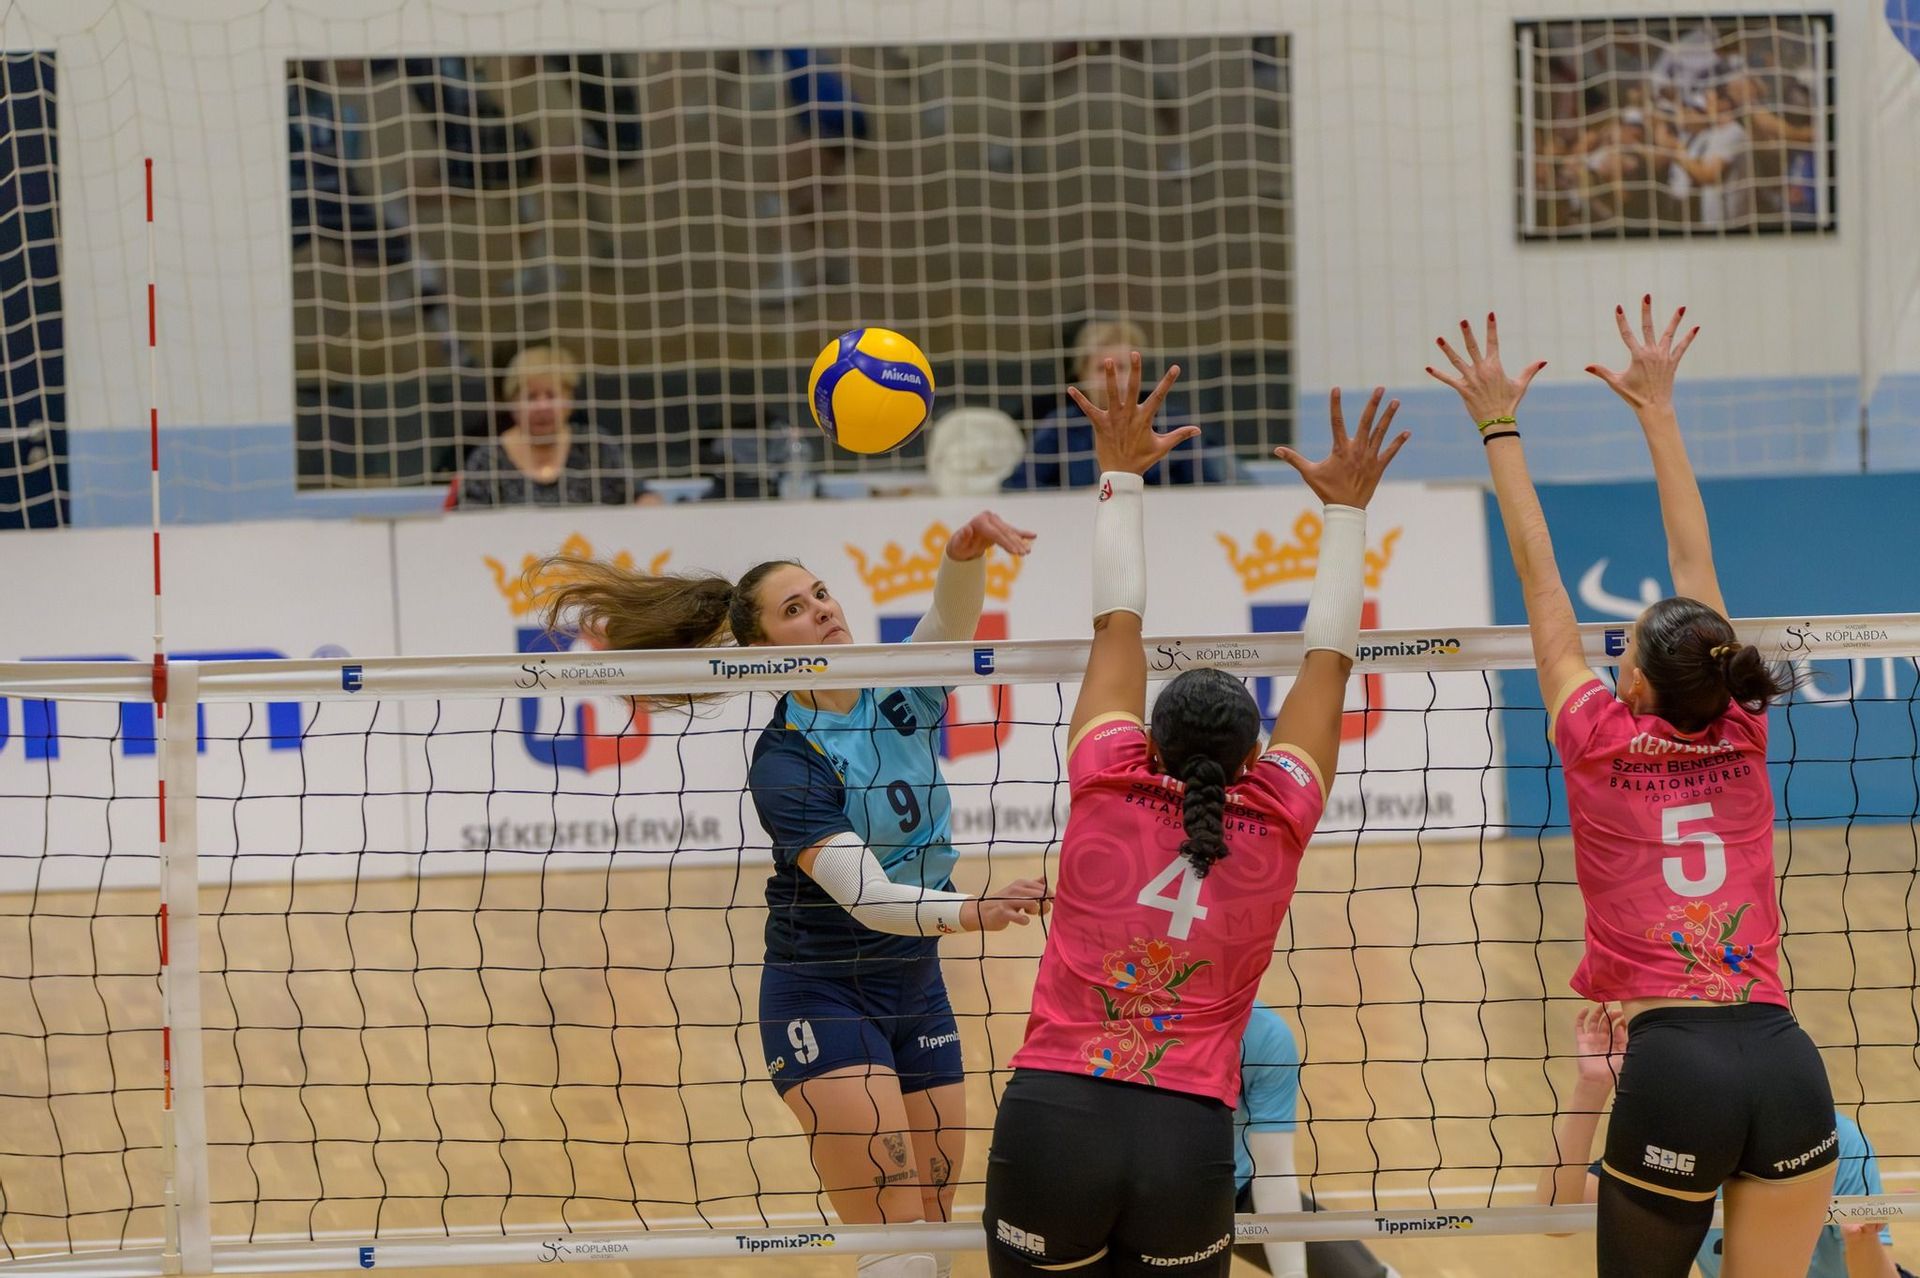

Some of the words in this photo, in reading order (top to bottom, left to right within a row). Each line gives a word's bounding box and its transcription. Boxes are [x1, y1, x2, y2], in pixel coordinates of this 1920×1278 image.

[1825, 630, 1888, 642] RÖPLABDA
[1195, 648, 1260, 661] RÖPLABDA
[1355, 638, 1461, 661] ippmixPRO
[561, 666, 625, 679] RÖPLABDA
[708, 656, 828, 680] TippmixPRO
[1609, 765, 1751, 792] BALATONFÜRED
[1644, 785, 1724, 803] röplabda
[886, 780, 921, 833] 9
[461, 813, 721, 849] SZÉKESFEHÉRVÁR
[1661, 802, 1727, 898] 5
[1136, 851, 1209, 942] 4
[786, 1018, 820, 1065] 9
[917, 1030, 961, 1050] Tippmi
[1850, 1206, 1904, 1217] RÖPLABDA
[1235, 1225, 1270, 1236] LABDA
[1374, 1215, 1474, 1235] TippmixPRO
[575, 1242, 629, 1254] RÖPLABDA
[735, 1233, 836, 1253] TippmixPRO
